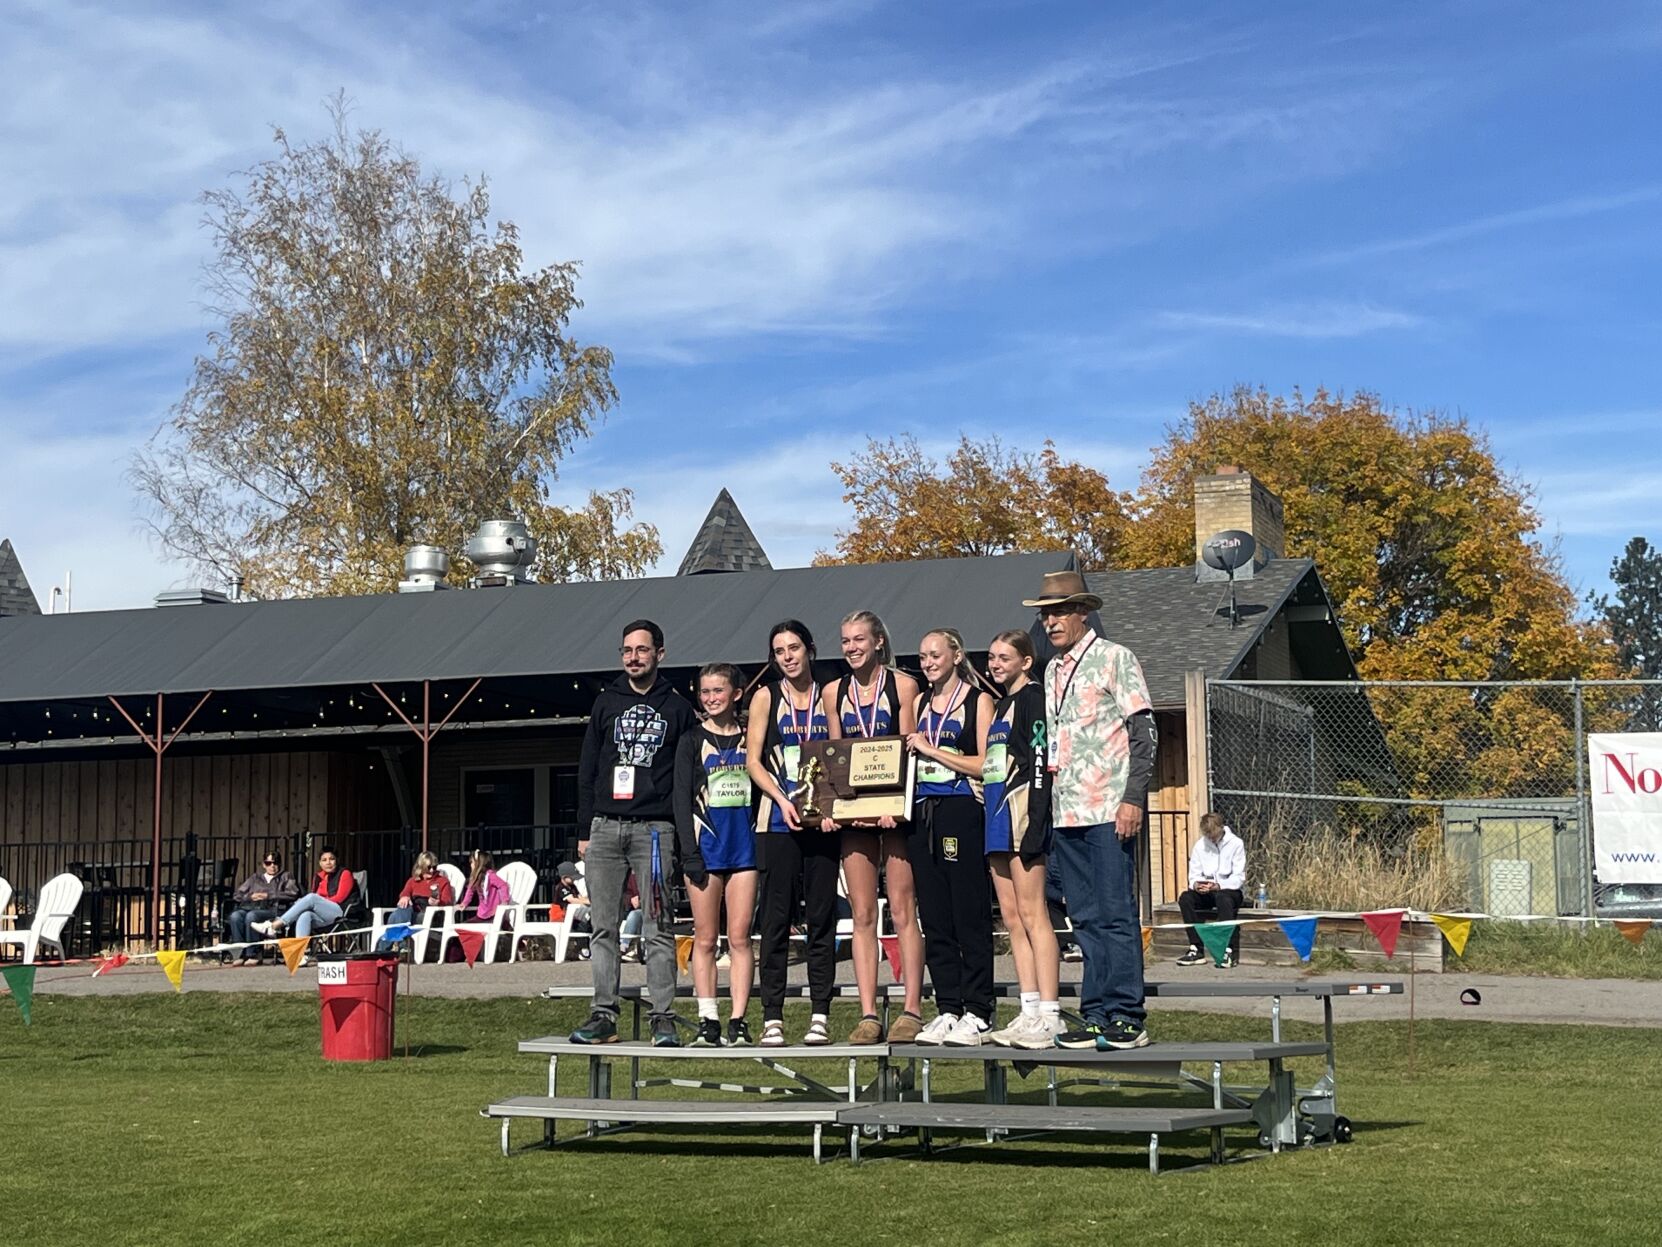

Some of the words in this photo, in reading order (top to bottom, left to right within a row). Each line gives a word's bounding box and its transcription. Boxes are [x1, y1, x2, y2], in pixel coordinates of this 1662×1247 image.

[621, 719, 662, 730] STATE
[860, 745, 893, 753] 2024-2025
[864, 763, 886, 771] STATE
[1034, 744, 1044, 789] KALE
[853, 772, 896, 782] CHAMPIONS
[716, 790, 746, 798] TAYLOR
